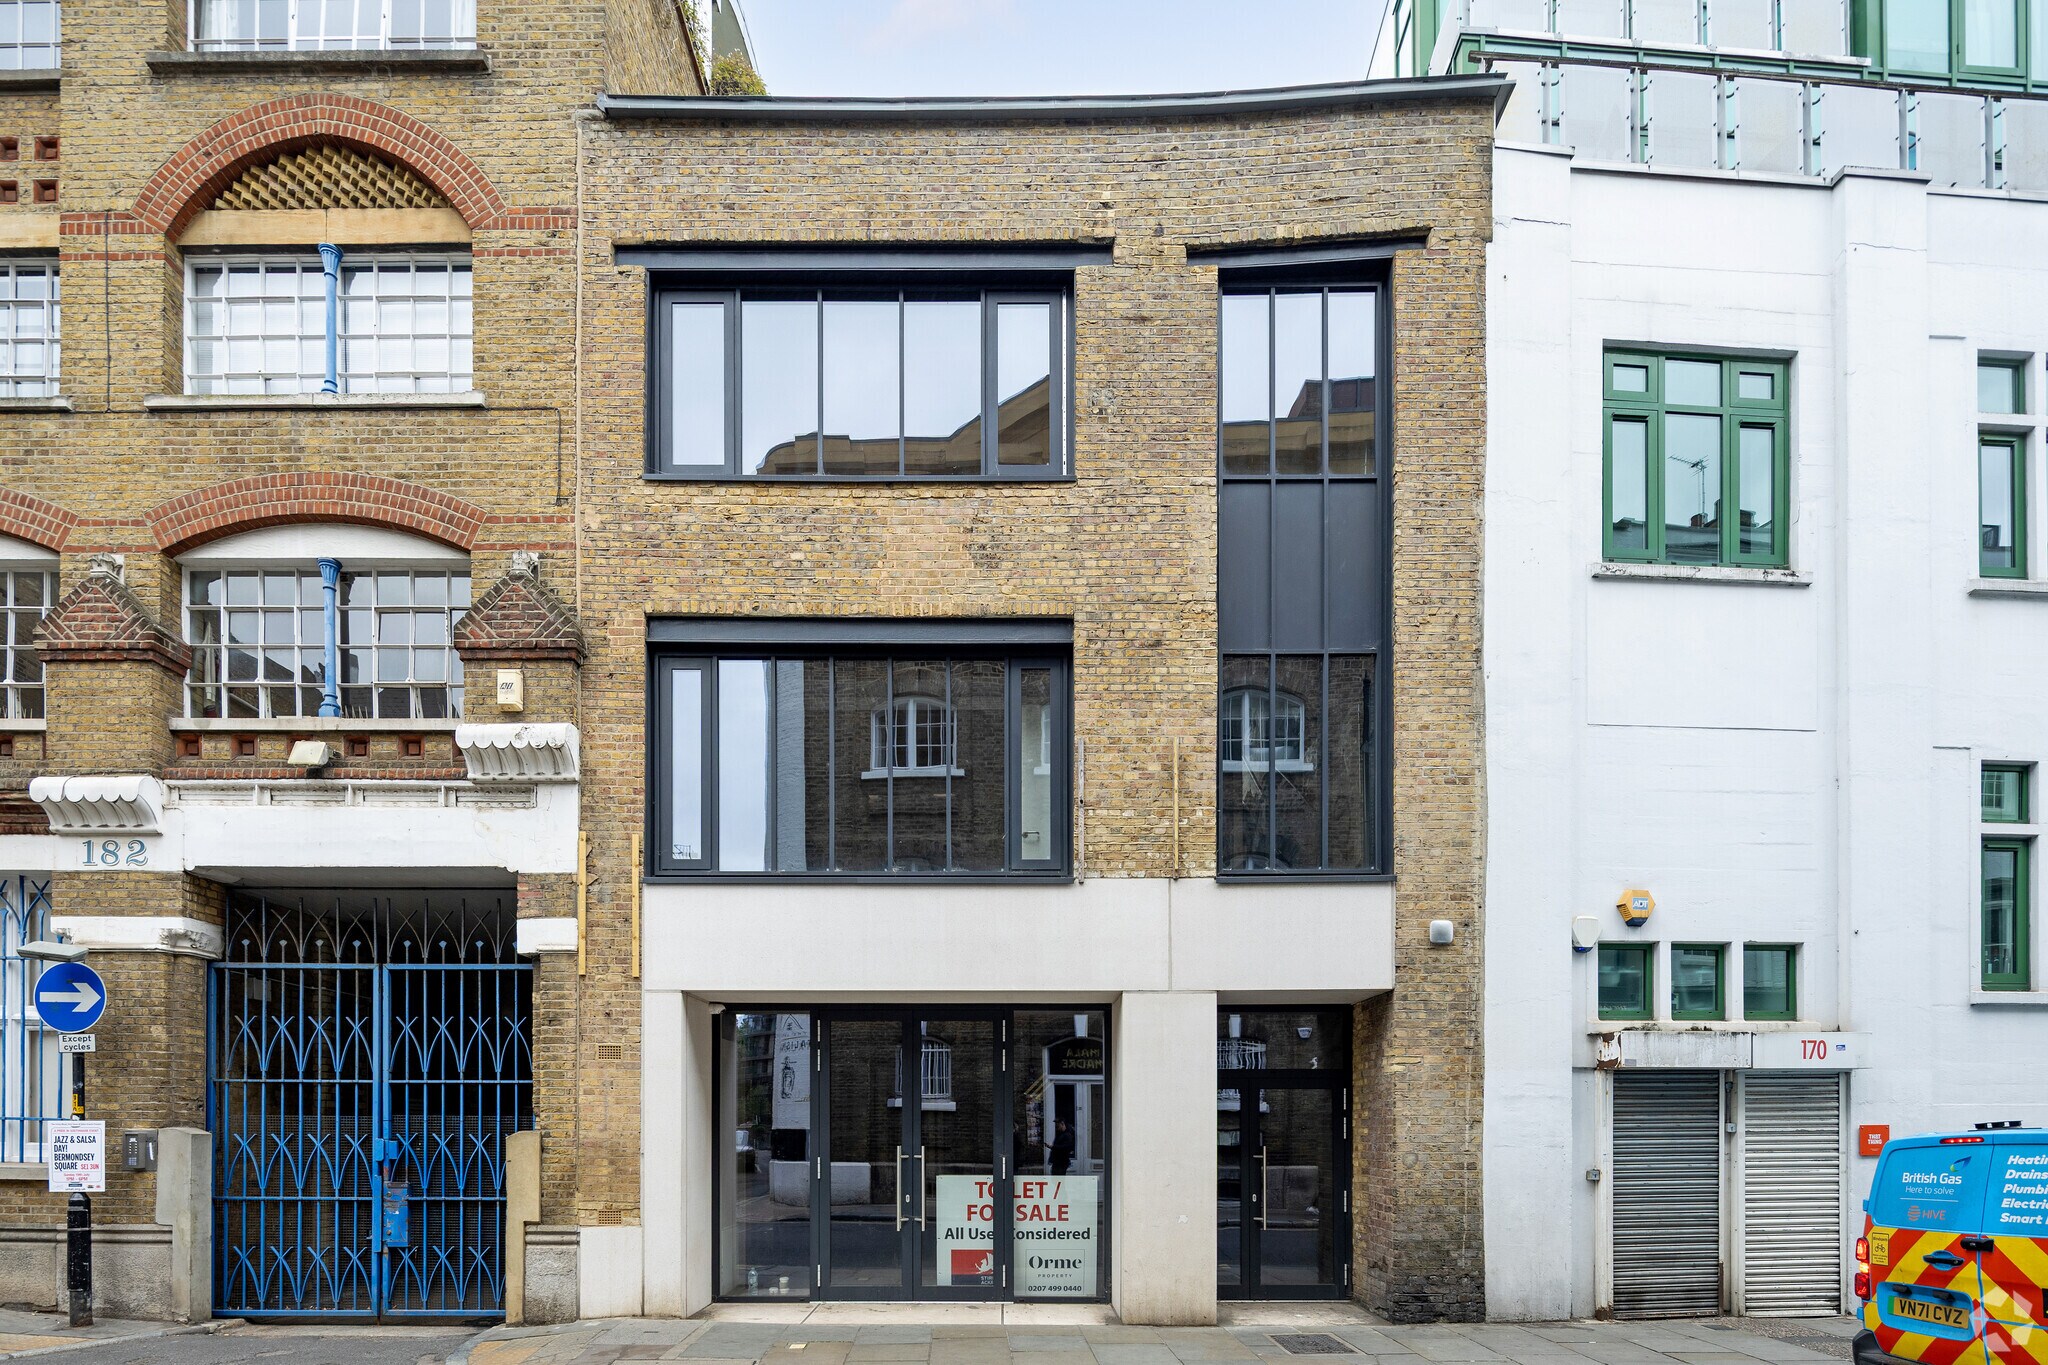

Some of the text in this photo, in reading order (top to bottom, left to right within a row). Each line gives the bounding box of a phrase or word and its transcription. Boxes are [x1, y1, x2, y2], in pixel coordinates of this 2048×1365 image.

[82, 839, 149, 867] 182
[1633, 900, 1648, 908] ADT
[62, 1035, 92, 1043] Except
[63, 1043, 91, 1051] cycles
[1800, 1040, 1827, 1060] 170
[53, 1135, 97, 1144] JAZZ & SALSA
[53, 1144, 68, 1153] DAY!
[53, 1153, 95, 1161] BERMONDSEY
[54, 1162, 78, 1171] SQUARE
[1901, 1172, 1962, 1185] British Gas
[2005, 1169, 2048, 1179] Drains
[1013, 1181, 1048, 1199] LET
[1905, 1186, 1923, 1194] Here
[1933, 1186, 1955, 1195] solve
[967, 1204, 1069, 1222] FO SALE
[1922, 1210, 1946, 1221] HIVE
[1999, 1212, 2043, 1225] Smart
[944, 1227, 1091, 1240] All Use onsidered
[1028, 1255, 1082, 1269] Orme
[1899, 1299, 1963, 1325] VN71 CVZ
